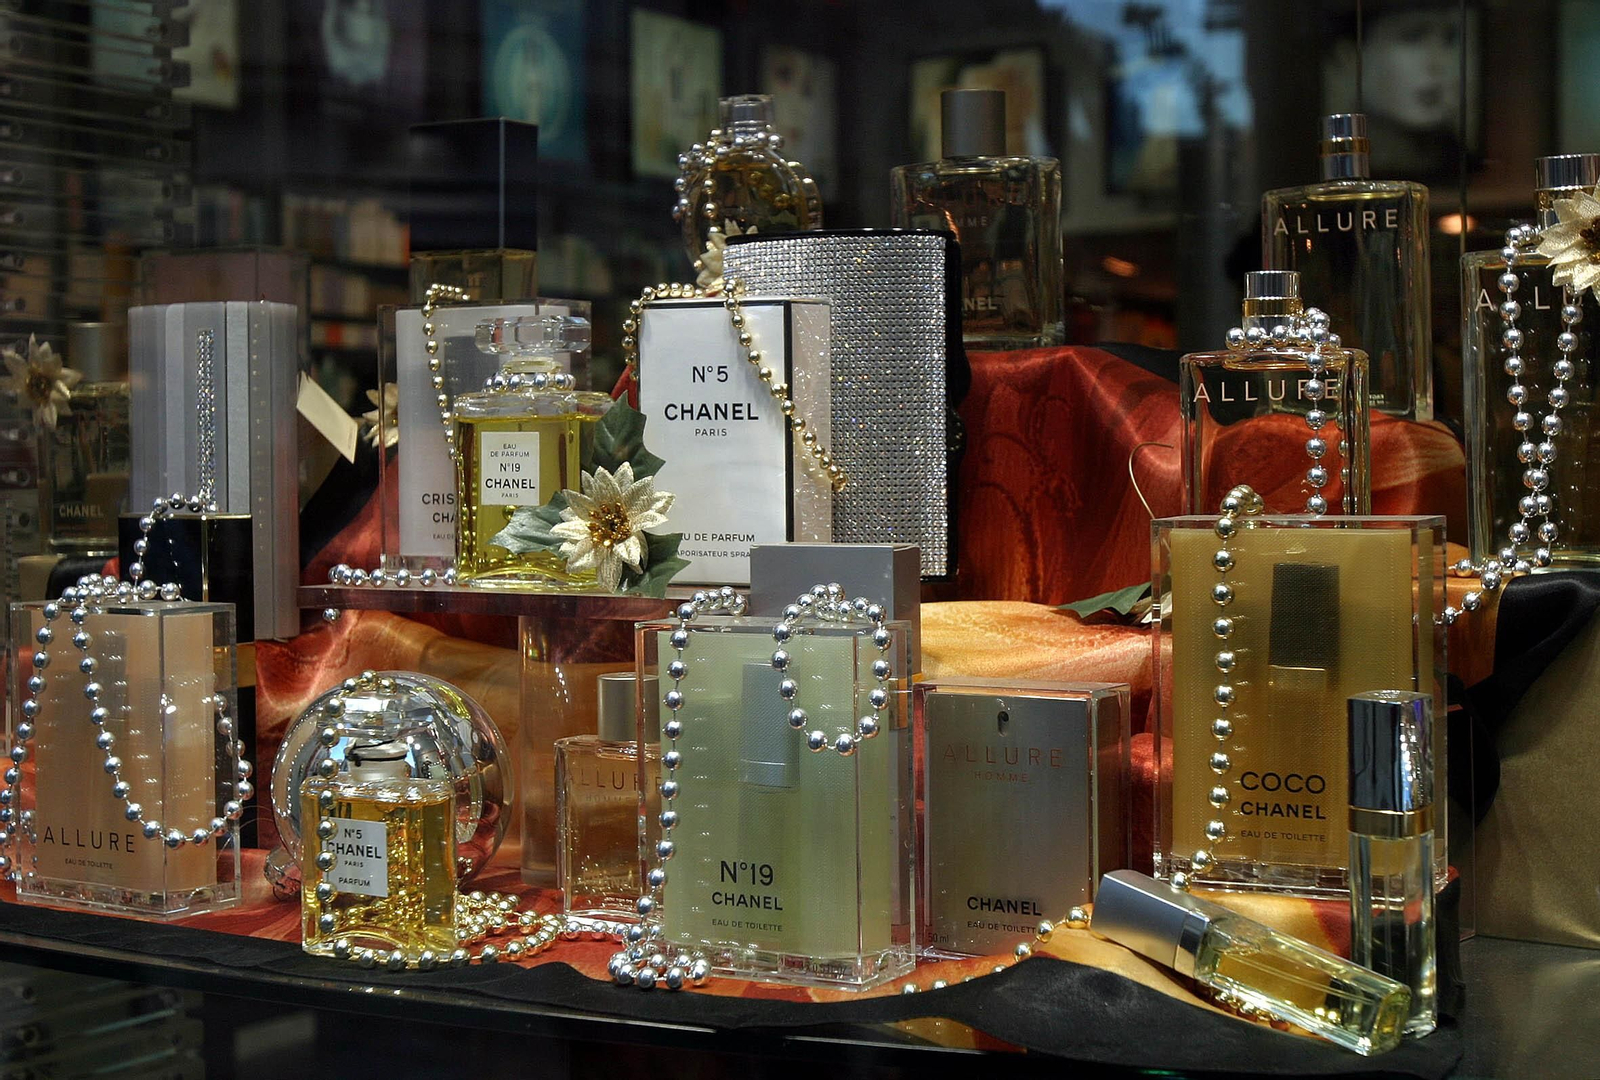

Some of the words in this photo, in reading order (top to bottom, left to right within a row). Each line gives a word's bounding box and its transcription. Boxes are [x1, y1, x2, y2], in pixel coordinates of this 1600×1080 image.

[1273, 208, 1399, 236] ALLURE
[664, 402, 759, 421] CHANEL
[694, 428, 728, 437] PARIS
[485, 478, 536, 490] CHANEL
[59, 503, 104, 518] CHANEL
[432, 512, 456, 523] CH
[694, 533, 708, 541] DE
[711, 533, 755, 542] PARFUM
[677, 549, 728, 558] PORISATEUR
[943, 744, 1064, 770] ALLURE
[974, 771, 1030, 783] HOMME
[1240, 771, 1326, 795] COCO
[1240, 801, 1327, 820] CHANEL
[43, 826, 136, 853] ALLURE
[1241, 829, 1261, 838] EAU
[1264, 831, 1278, 840] DE
[1280, 832, 1326, 843] TOILETTE
[65, 858, 77, 866] EAU
[78, 859, 87, 867] DE
[344, 860, 365, 868] PARIS
[338, 876, 371, 888] PARFUM
[711, 891, 784, 912] CHANEL
[967, 895, 1043, 917] CHANEL
[712, 918, 729, 928] EAU
[731, 920, 743, 930] DE
[745, 921, 784, 933] TOILETTE
[967, 920, 985, 930] EAU
[987, 922, 999, 931] DE
[1002, 923, 1037, 934] TOILETT
